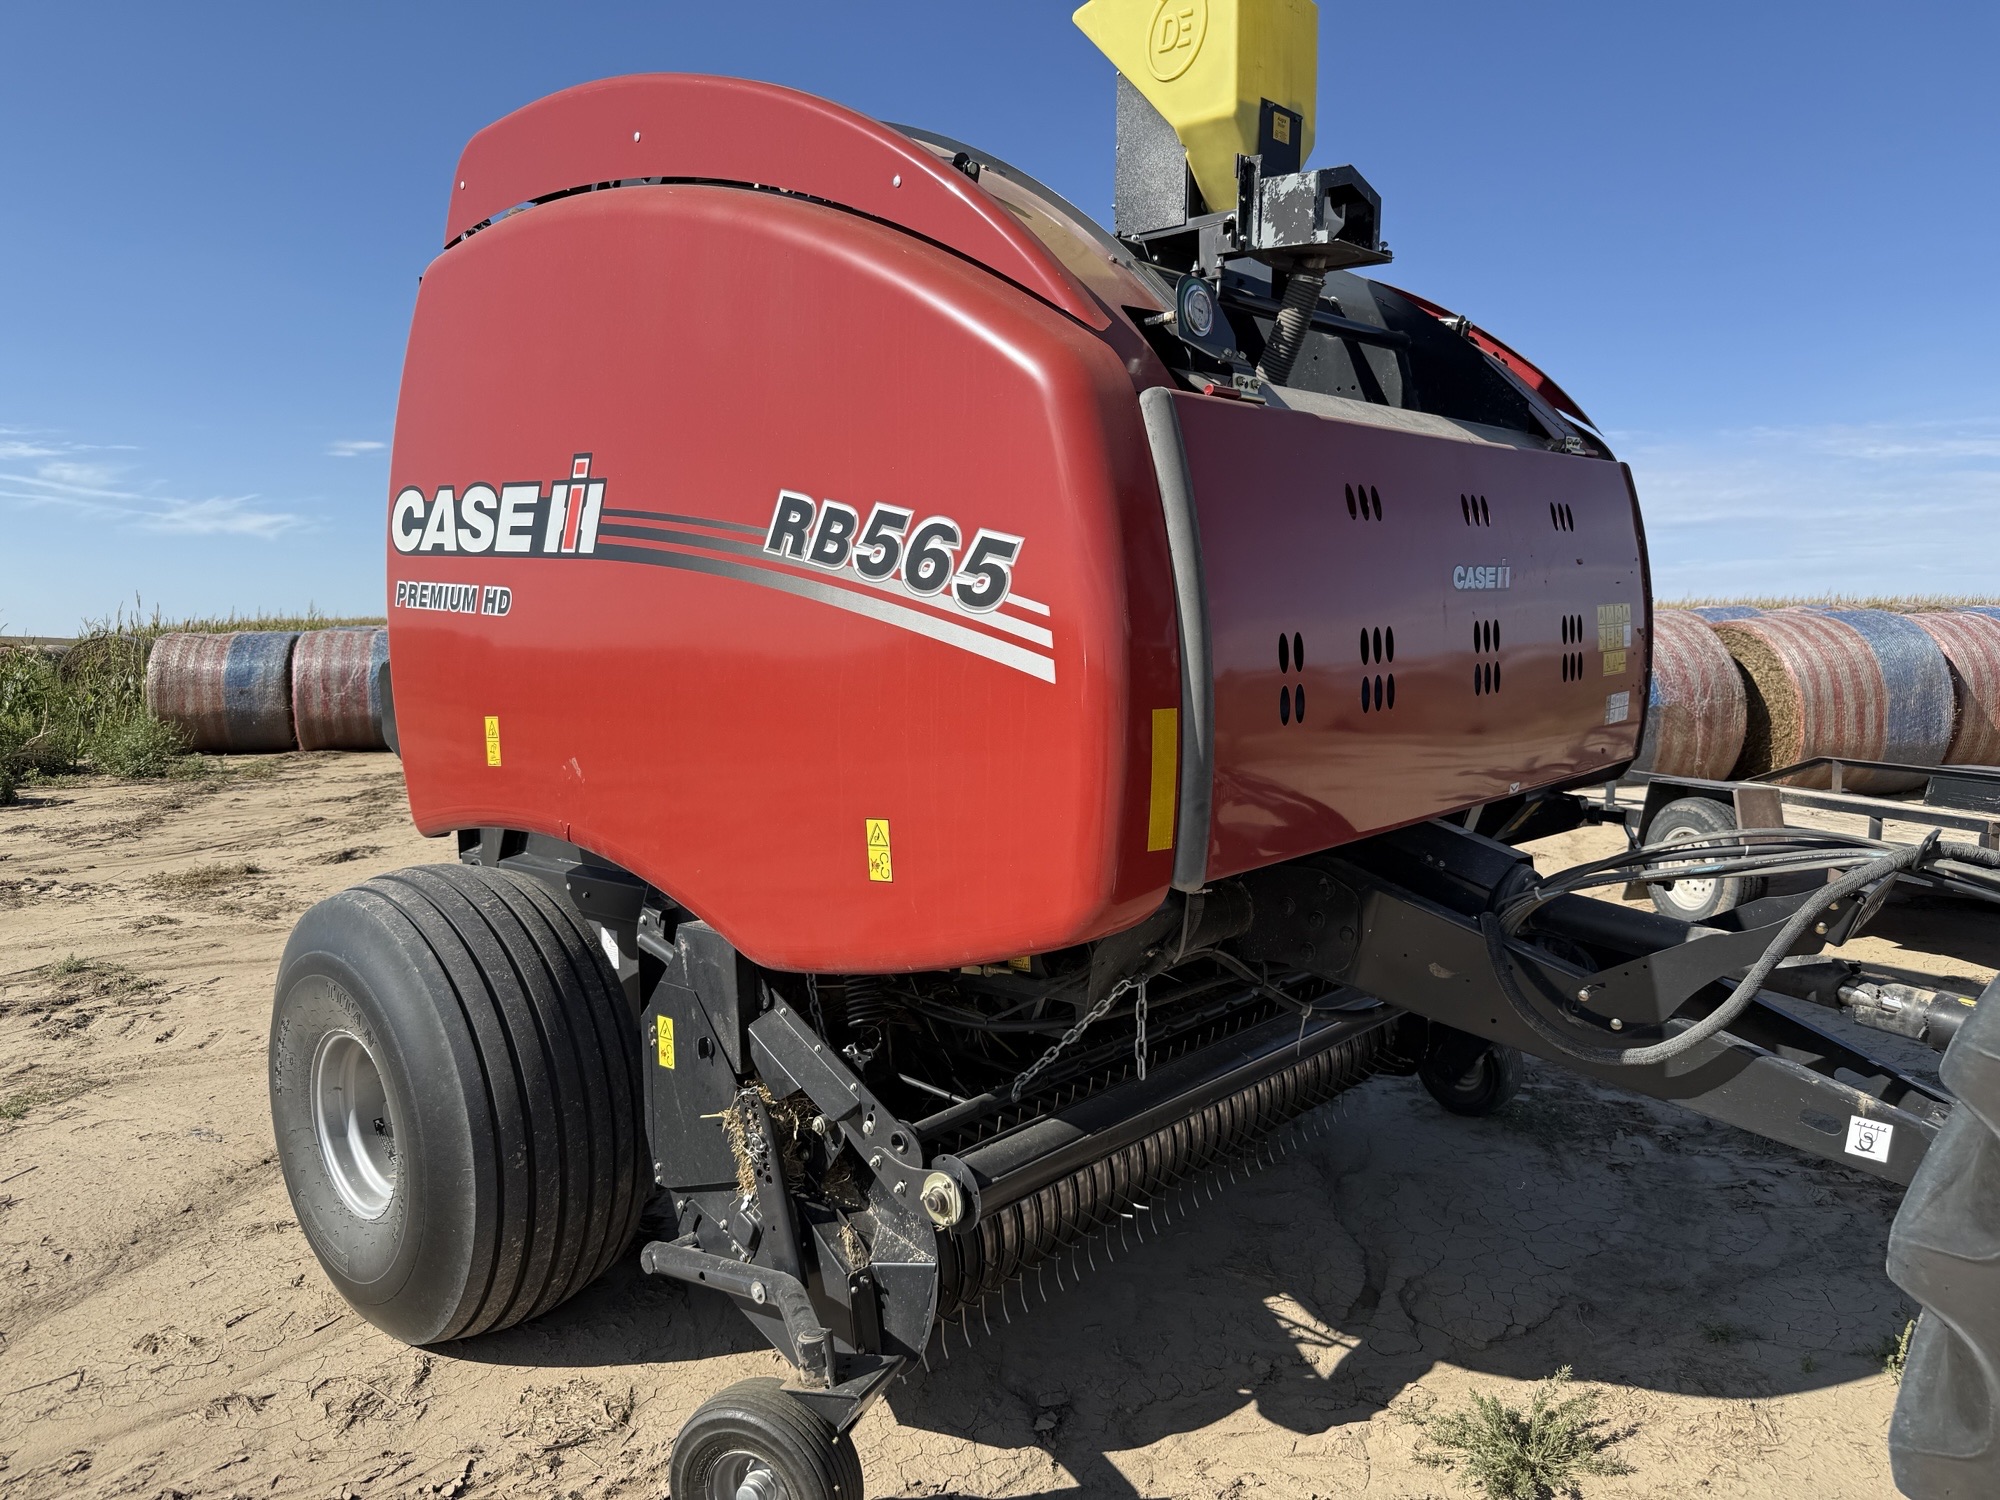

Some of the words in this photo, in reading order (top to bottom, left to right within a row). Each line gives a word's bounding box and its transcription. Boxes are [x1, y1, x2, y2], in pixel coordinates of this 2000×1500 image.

[1158, 8, 1194, 54] DE
[763, 488, 1026, 614] RB565
[395, 581, 479, 615] PREMIUM
[480, 585, 513, 617] HD
[326, 981, 378, 1048] TITAN
